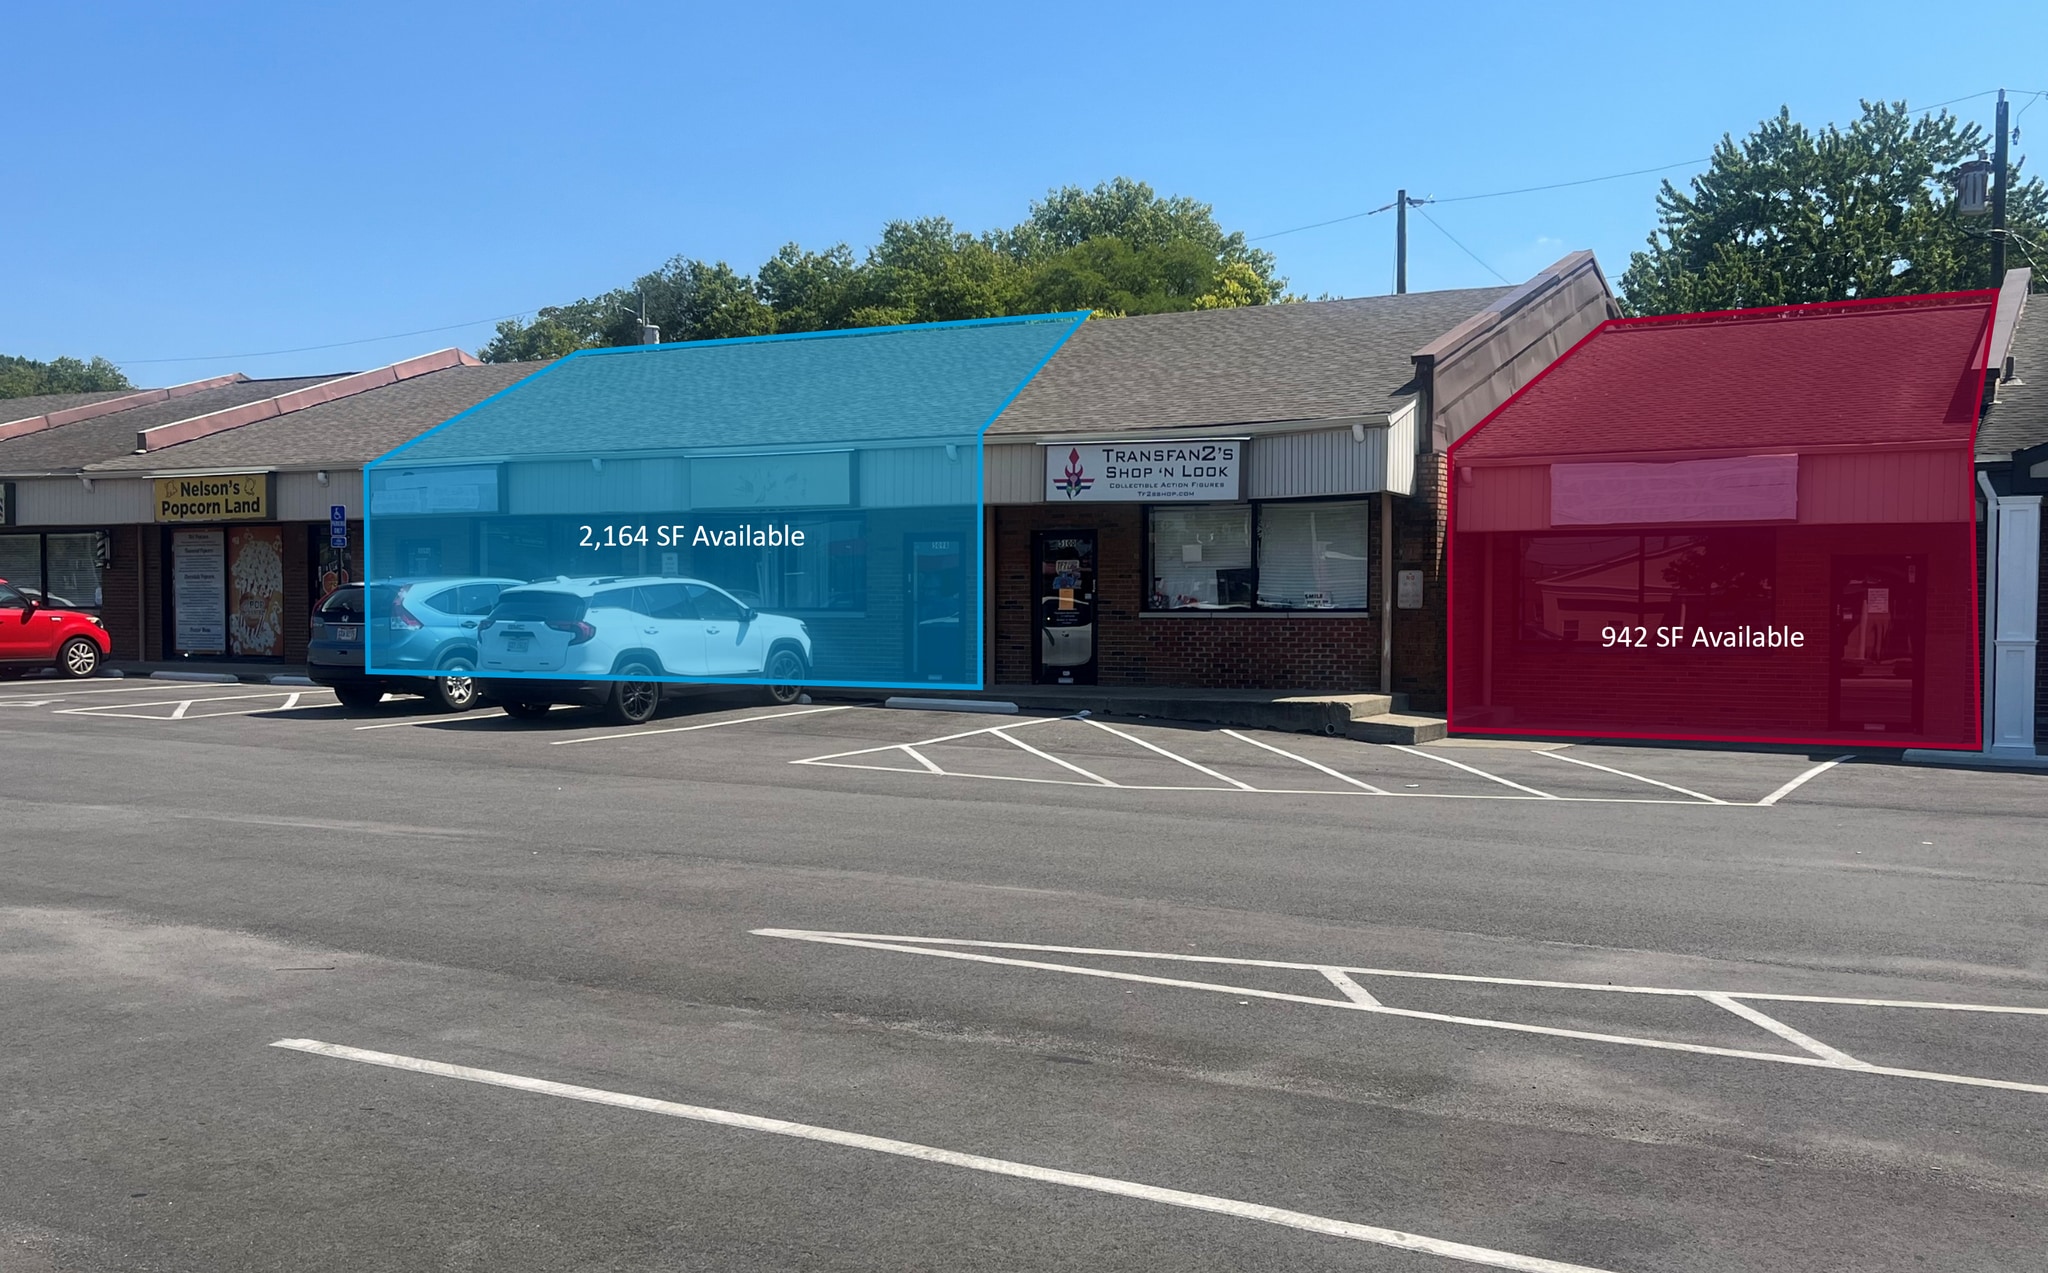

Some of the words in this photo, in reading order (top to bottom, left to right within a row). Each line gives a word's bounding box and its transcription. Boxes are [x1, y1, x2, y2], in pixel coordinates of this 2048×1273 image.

[1106, 466, 1153, 479] SHOP
[1181, 465, 1229, 478] LOOK
[180, 480, 240, 497] Nelson's
[161, 501, 220, 518] Popcorn
[225, 497, 260, 513] Land
